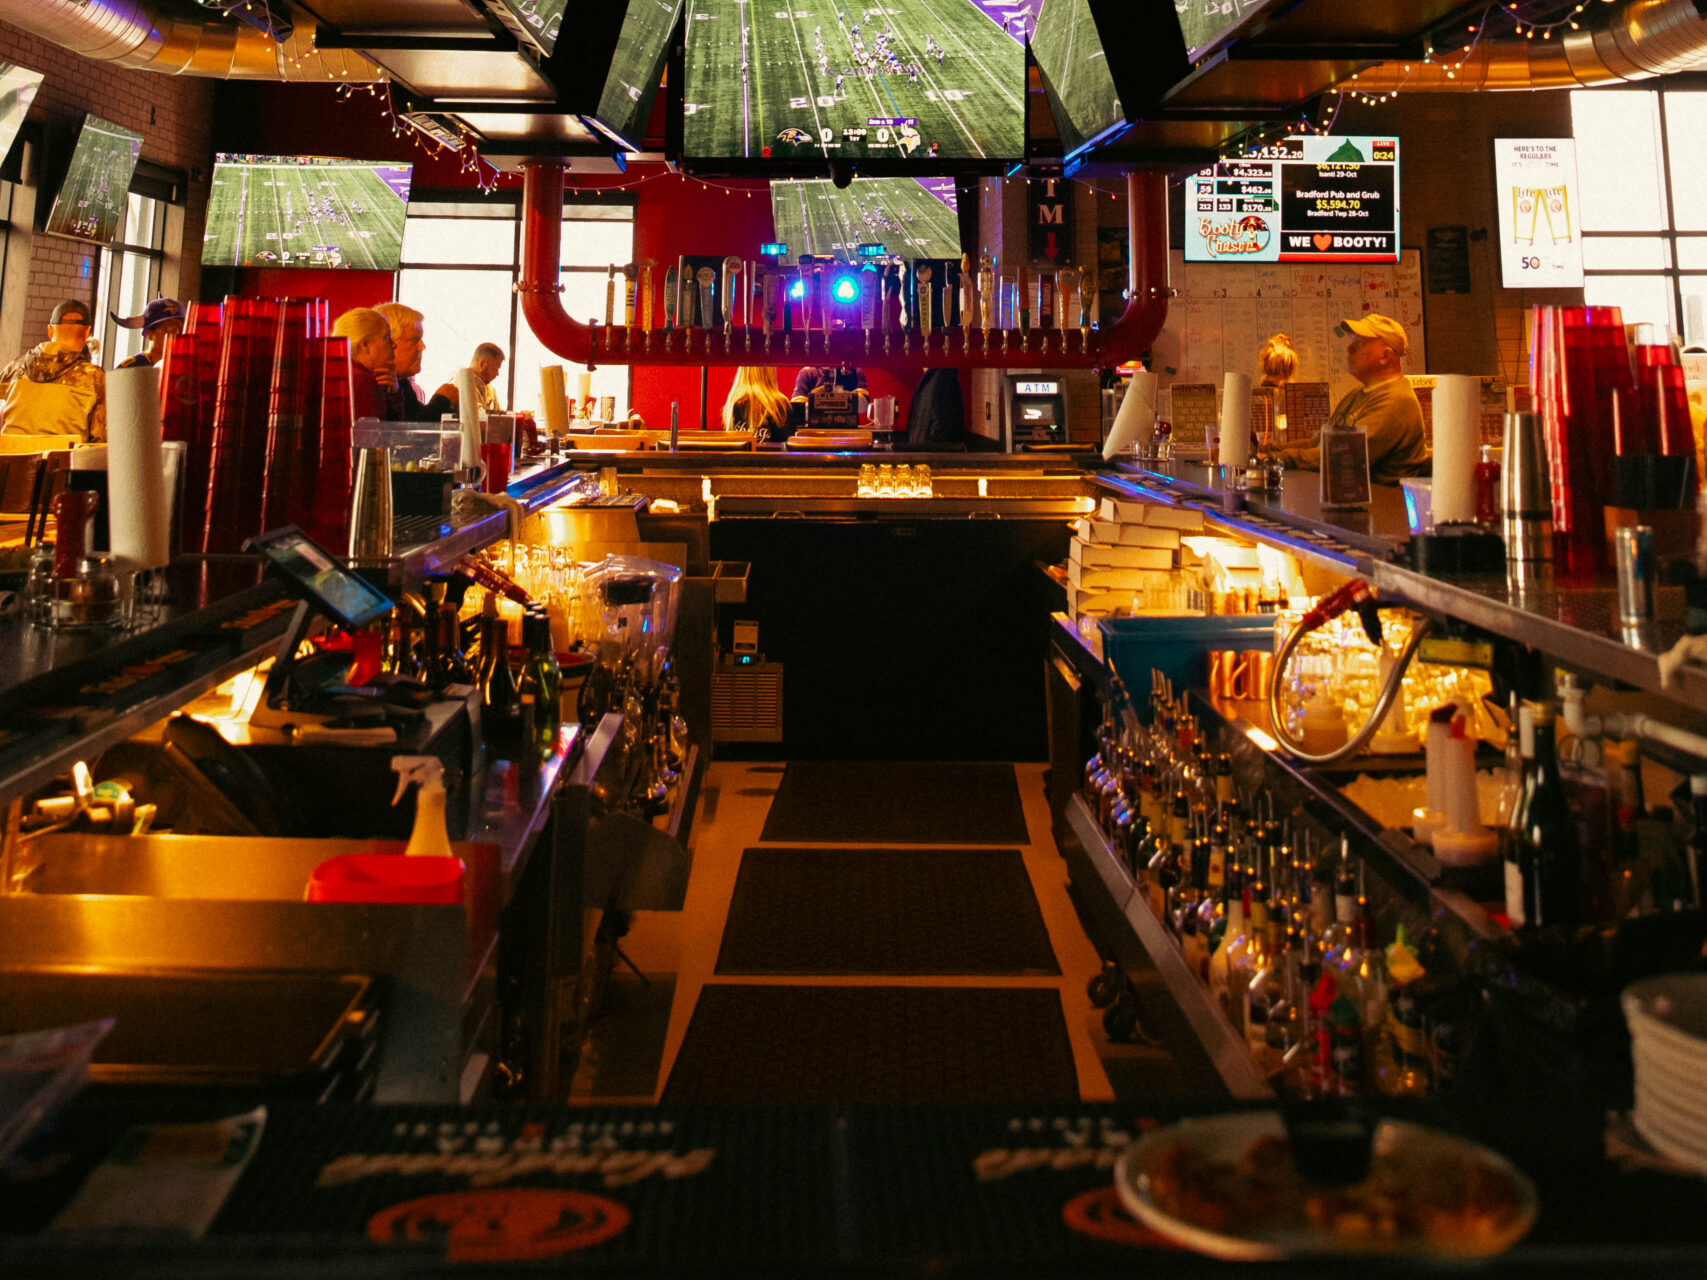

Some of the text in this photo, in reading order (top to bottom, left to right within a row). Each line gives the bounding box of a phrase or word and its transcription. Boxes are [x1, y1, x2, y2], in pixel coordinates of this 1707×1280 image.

[1373, 151, 1394, 160] 0:24
[1296, 190, 1380, 200] Bradford Pub and Grub
[1316, 199, 1361, 210] $5,594.70
[1335, 210, 1347, 218] Twp
[1199, 217, 1246, 240] Booty
[1289, 236, 1387, 248] WE BOOTY!
[1024, 383, 1050, 392] ATM
